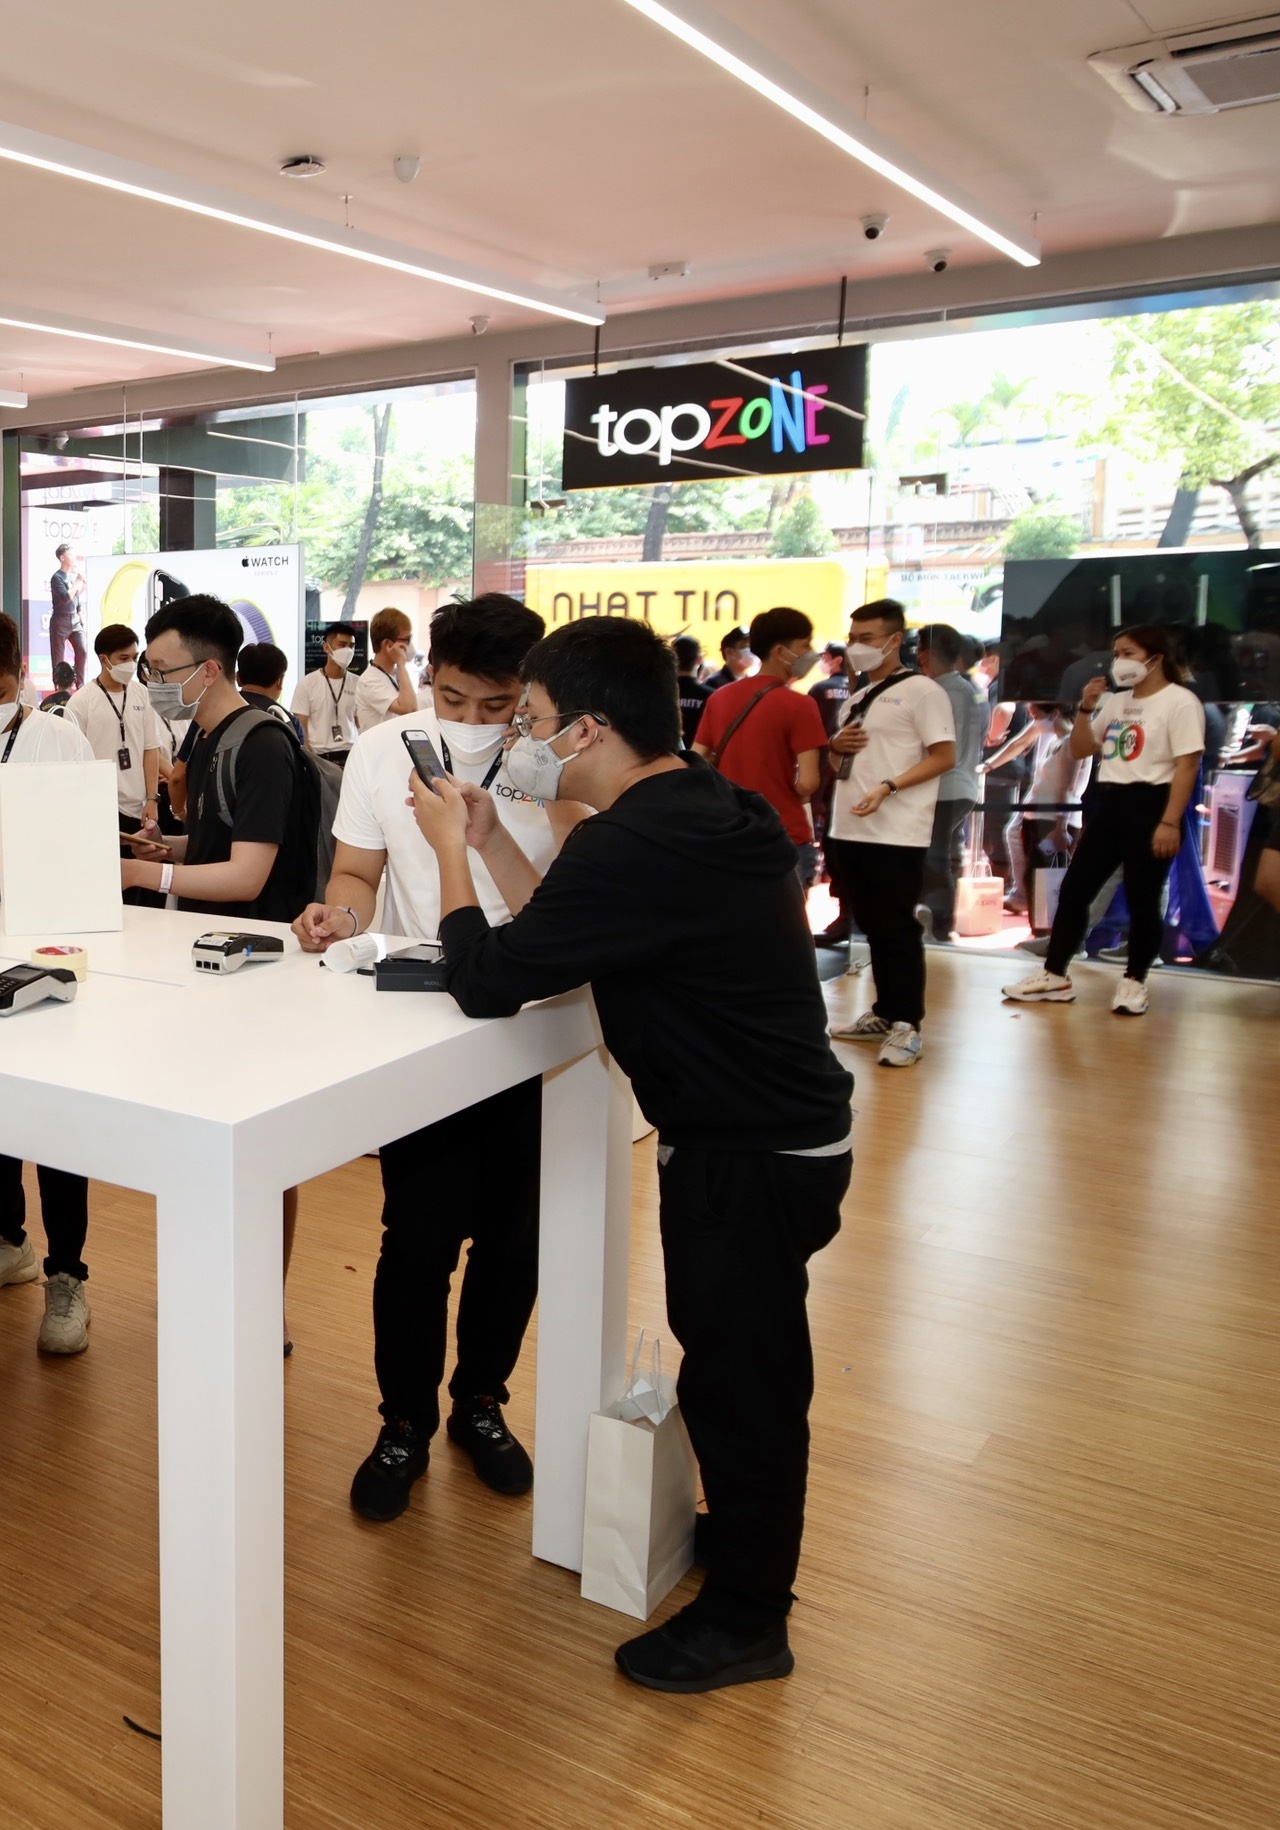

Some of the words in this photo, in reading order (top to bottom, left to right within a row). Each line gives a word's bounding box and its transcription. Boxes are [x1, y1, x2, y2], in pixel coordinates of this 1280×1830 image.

[251, 556, 289, 567] WATCH
[680, 698, 703, 708] RITY
[1101, 724, 1145, 762] 50
